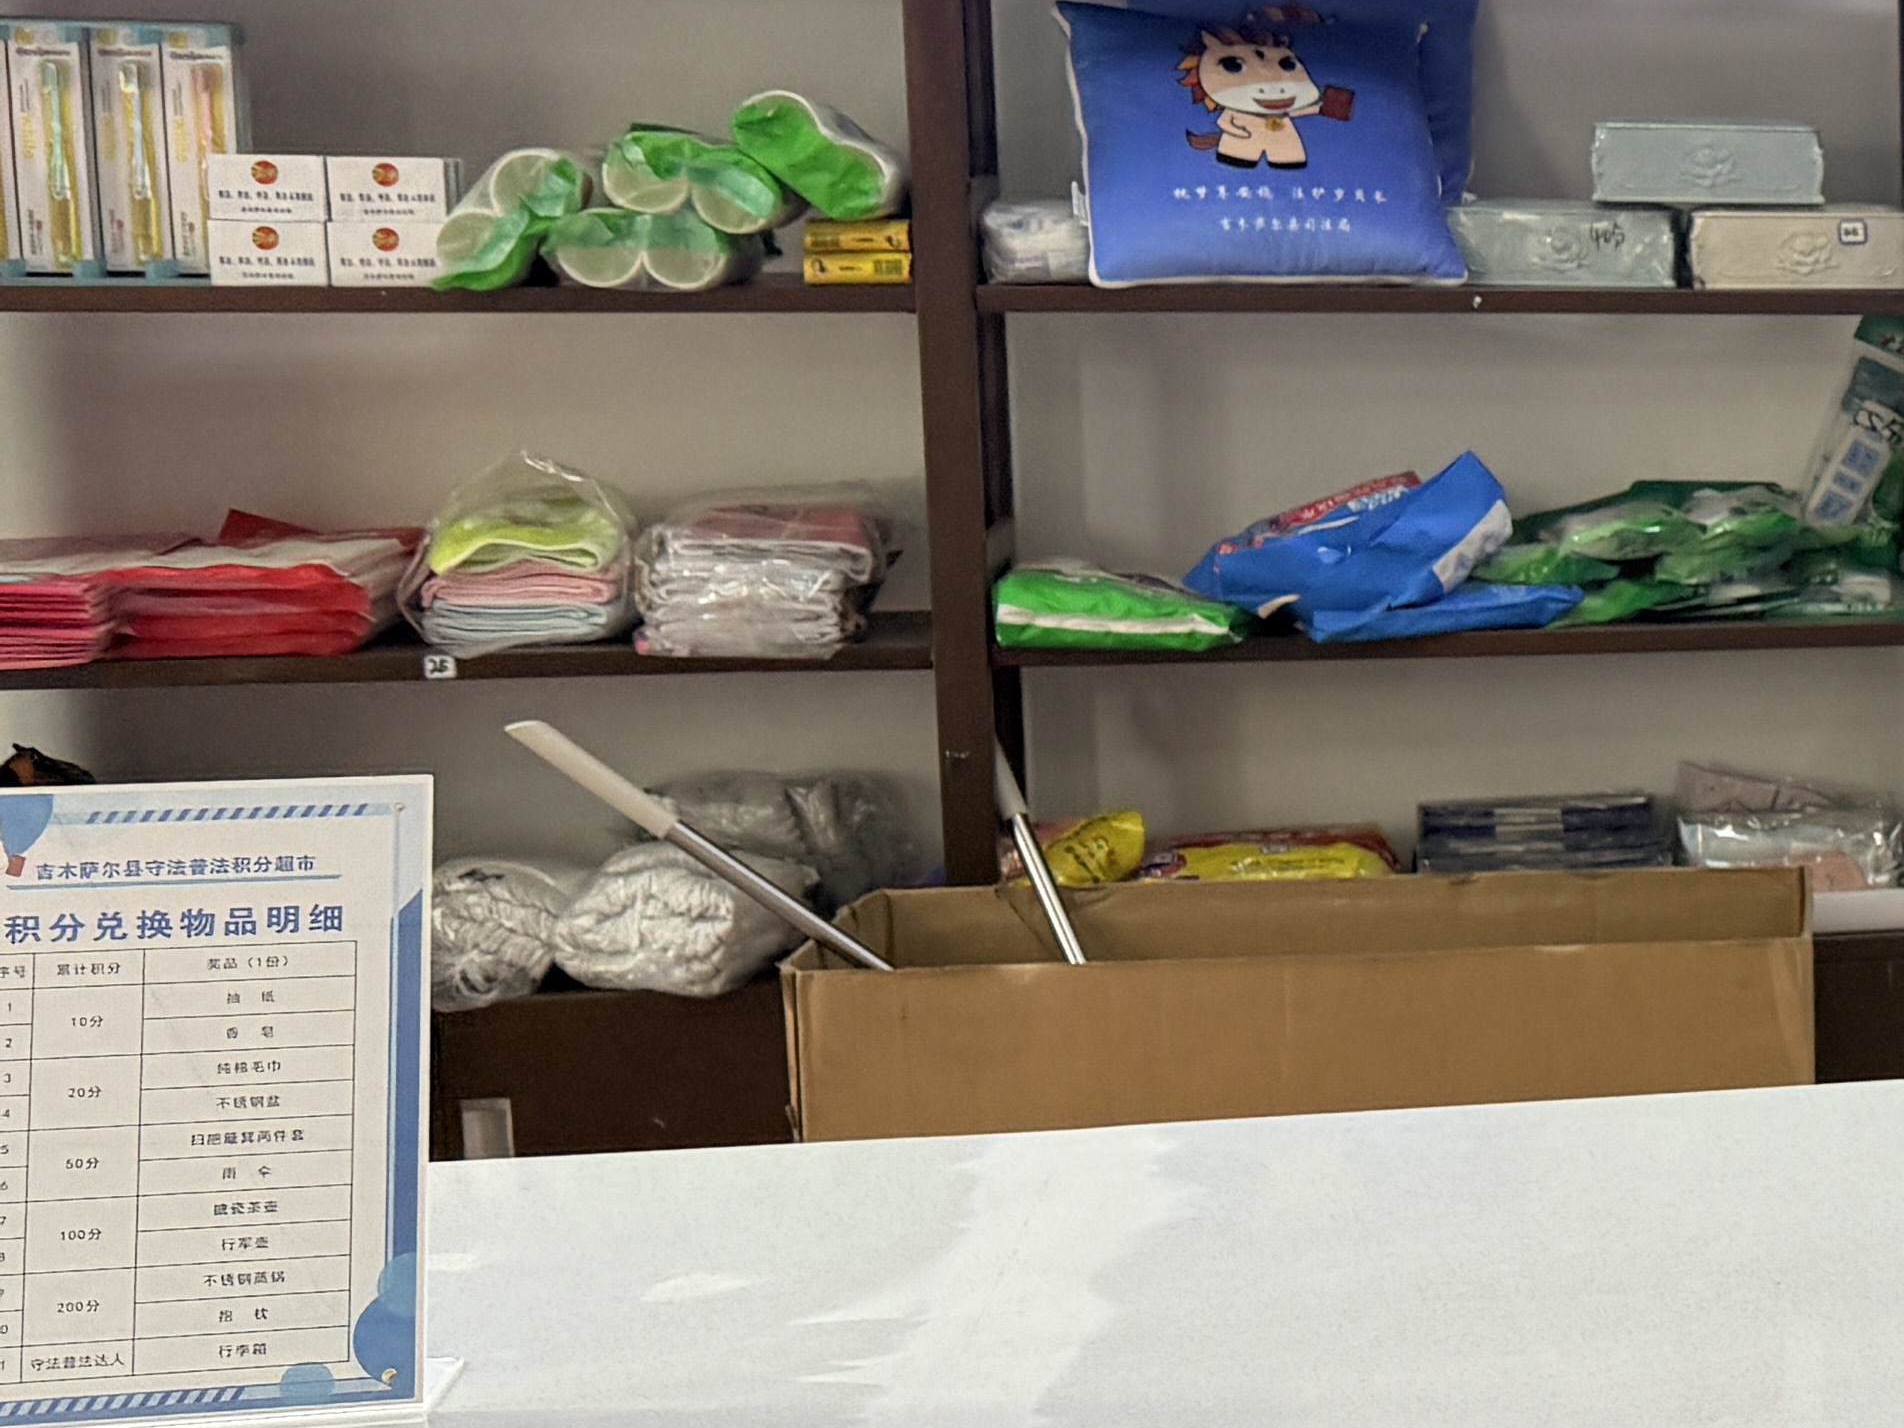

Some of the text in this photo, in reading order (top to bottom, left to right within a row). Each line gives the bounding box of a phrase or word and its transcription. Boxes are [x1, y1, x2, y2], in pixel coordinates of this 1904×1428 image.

[36, 854, 317, 881] 吉木萨尔县守法普法积分超市
[3, 903, 344, 945] 积分兑换物品明细
[71, 1015, 104, 1028] 10分
[67, 1085, 103, 1099] 20分
[60, 1227, 103, 1241] 100分
[56, 1299, 101, 1313] 200分
